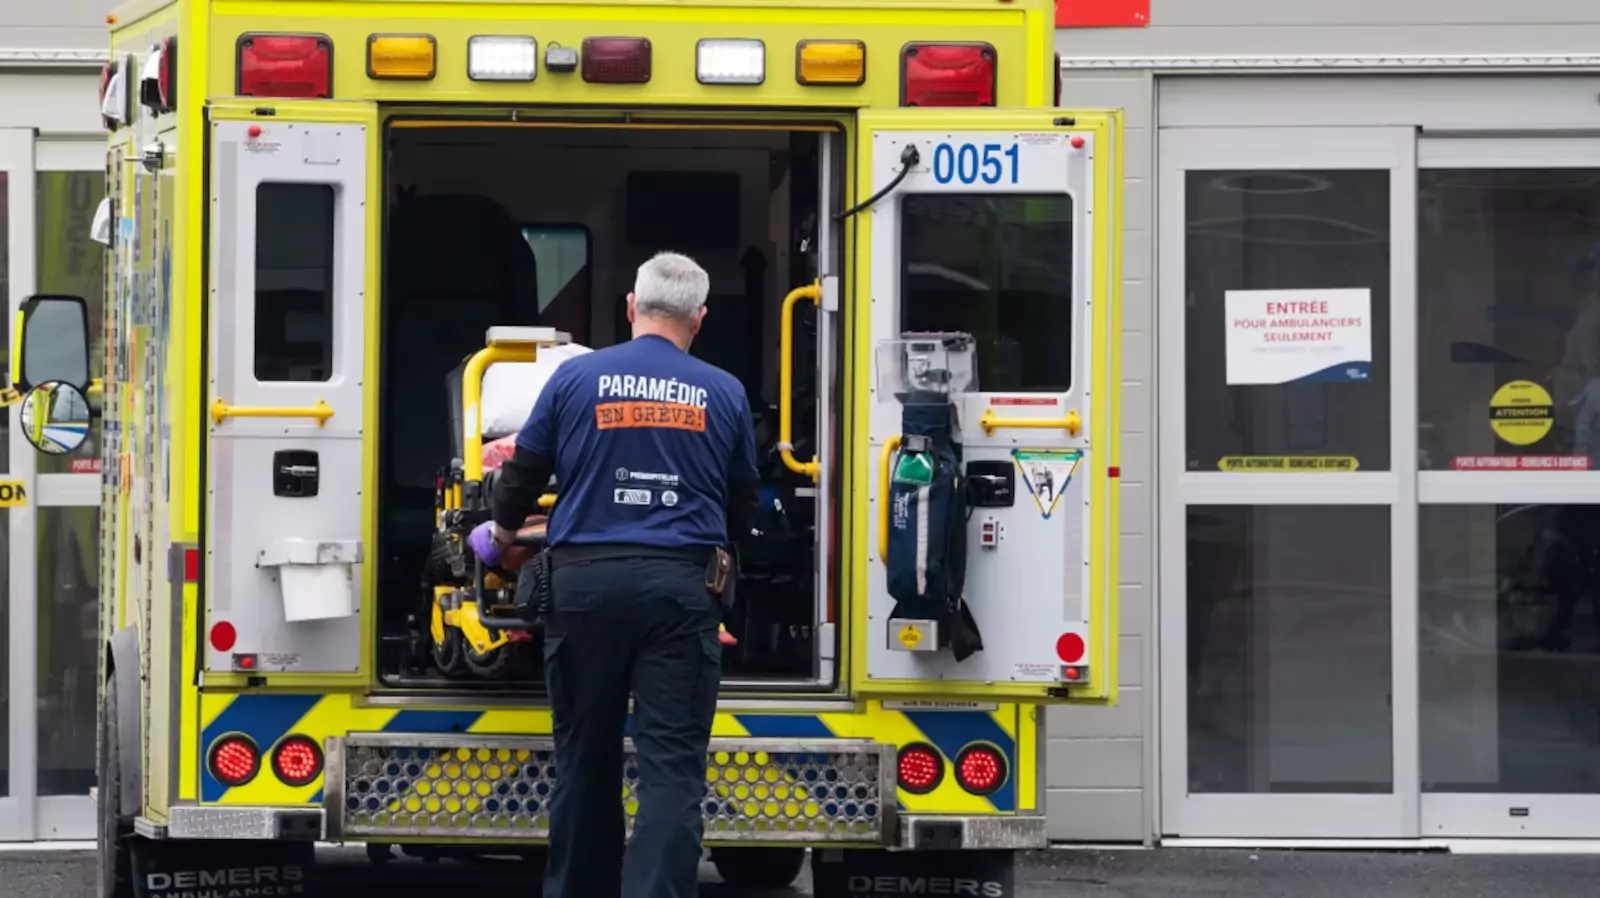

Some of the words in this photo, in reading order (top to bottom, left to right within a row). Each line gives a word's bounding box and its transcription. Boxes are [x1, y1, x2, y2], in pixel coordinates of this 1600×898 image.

[933, 143, 1019, 184] 0051
[1265, 299, 1329, 315] ENTRÉE
[1234, 319, 1267, 328] POUR
[1269, 317, 1362, 328] AMBULANCIERS
[1264, 332, 1332, 342] SEULEMENT
[598, 374, 708, 408] PARAMÉDIC
[600, 407, 624, 423] EN
[632, 403, 703, 427] GRÈVE!
[1495, 408, 1549, 416] ATTENTION
[147, 866, 303, 889] DEMERS
[849, 876, 1003, 897] DEMERS
